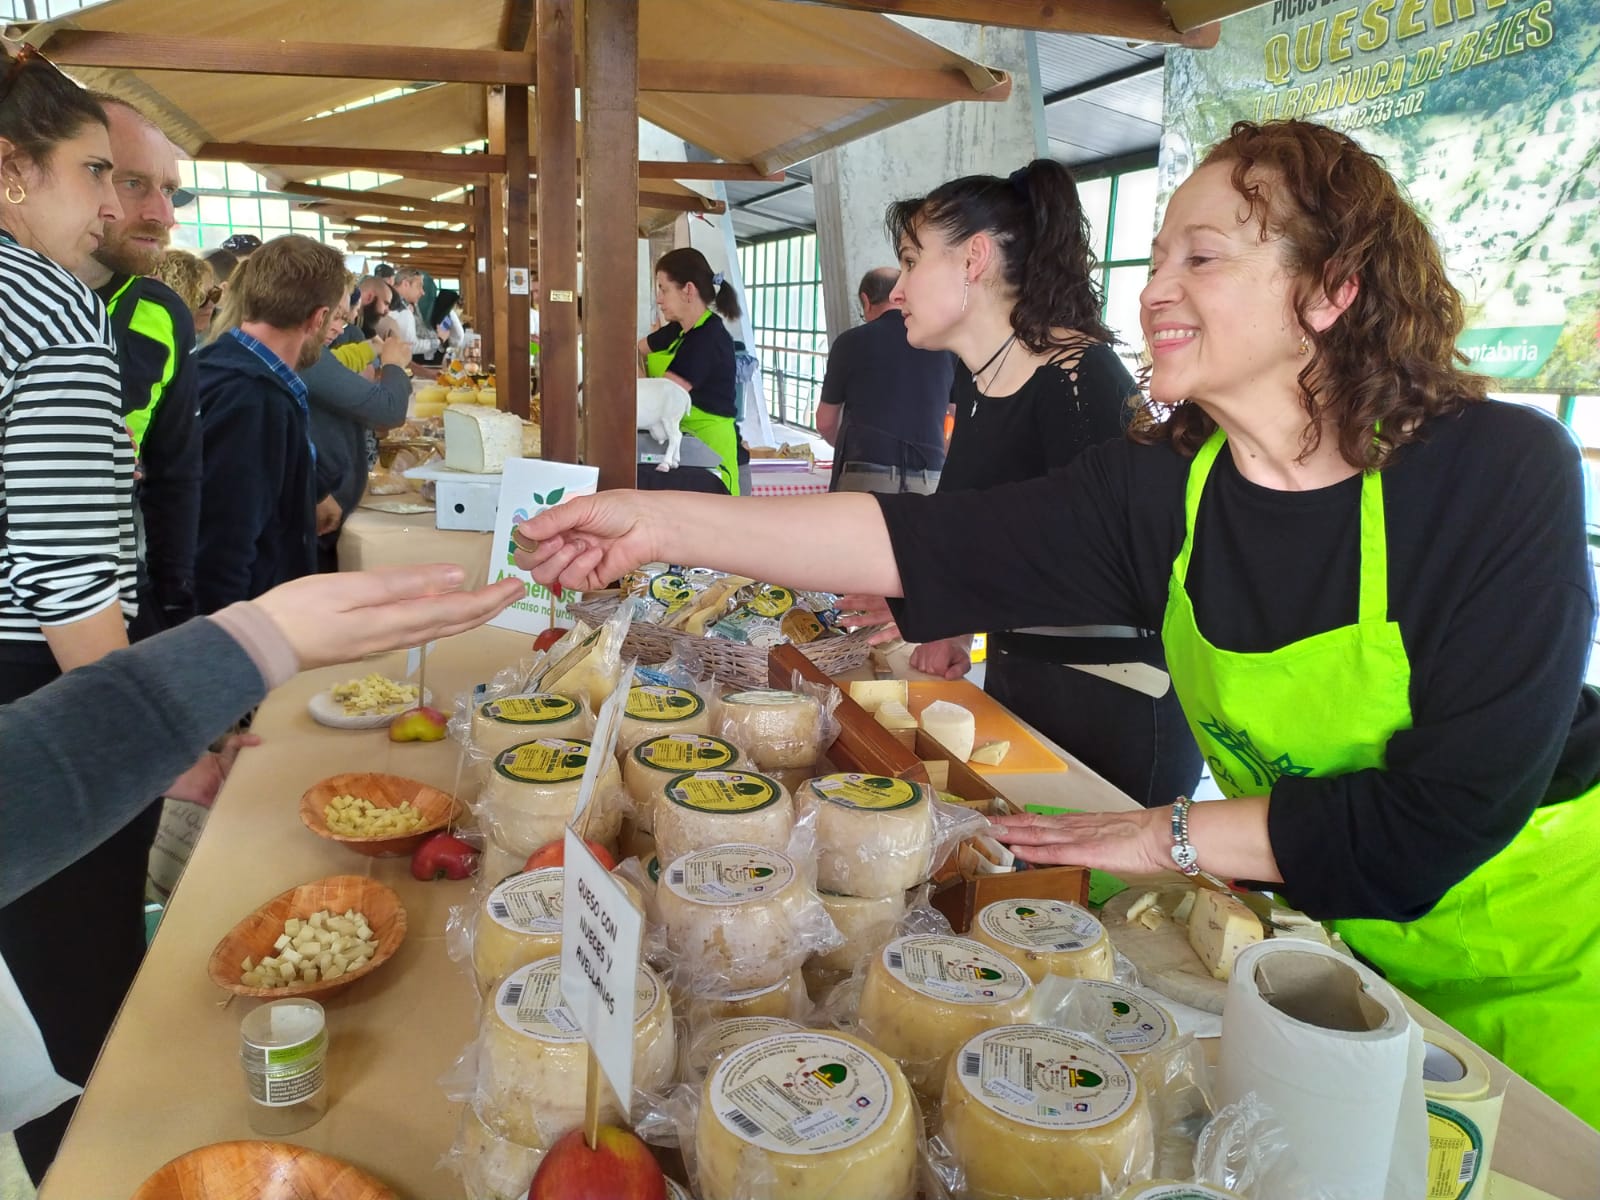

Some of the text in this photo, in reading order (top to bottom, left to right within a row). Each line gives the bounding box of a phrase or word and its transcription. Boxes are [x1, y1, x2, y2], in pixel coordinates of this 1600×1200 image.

[1265, 0, 1506, 87] QUESE
[1281, 54, 1407, 120] BRAÑUCA
[1408, 39, 1454, 87] DE
[1450, 0, 1553, 73] BEJES
[1368, 100, 1394, 124] 733
[1394, 90, 1425, 118] 502
[1458, 340, 1539, 363] ntabria
[541, 602, 574, 621] naural
[578, 877, 617, 943] QUESO CON
[580, 914, 613, 974] NUECES Y
[576, 945, 615, 1015] AVELLANAS
